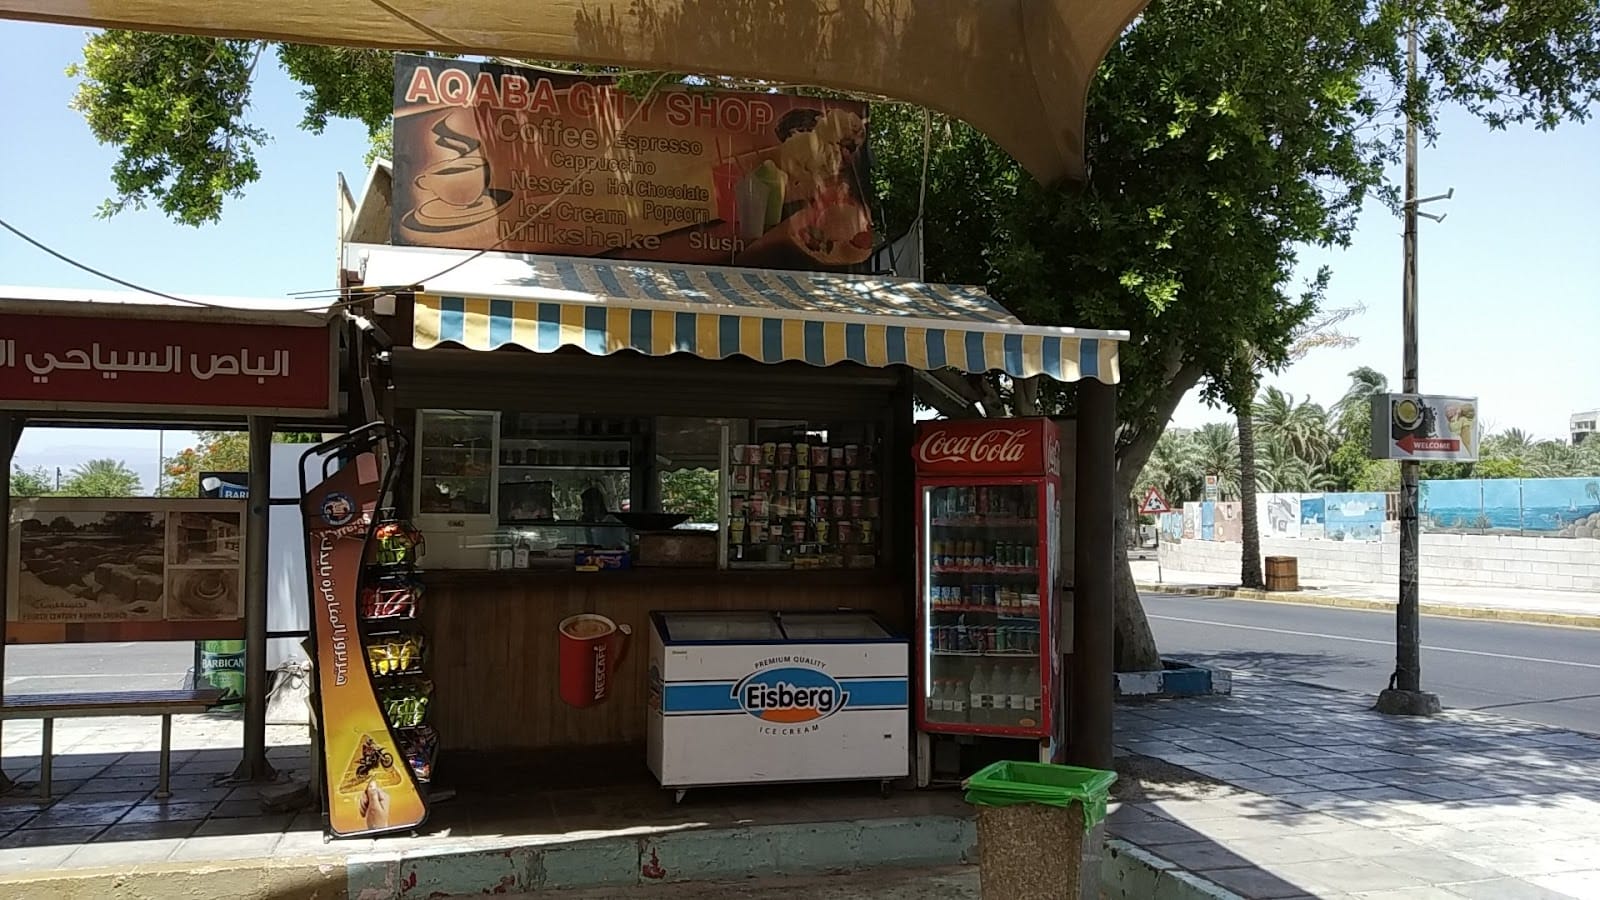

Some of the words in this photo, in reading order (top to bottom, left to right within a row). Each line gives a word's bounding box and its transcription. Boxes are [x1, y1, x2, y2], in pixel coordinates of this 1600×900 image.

[405, 66, 560, 115] AQABA
[567, 81, 660, 124] CITY
[666, 92, 774, 135] SHOP
[496, 114, 599, 150] Coffee
[614, 130, 703, 155] Espresso
[551, 150, 656, 175] Cappuccino
[607, 178, 634, 197] Hot
[636, 181, 709, 201] Chocolate
[518, 199, 551, 218] Ice
[556, 201, 627, 225] Cream
[644, 200, 710, 225] Popcorn
[499, 220, 661, 250] Milkshake
[688, 231, 745, 252] Slush
[24, 342, 182, 384] السياحي
[190, 348, 290, 384] الباص
[919, 428, 1033, 463] Coca-Cola
[1413, 441, 1451, 449] WELCOME
[224, 490, 249, 499] BAR
[202, 658, 245, 669] BARBICAN
[754, 656, 791, 669] PREMIUM
[793, 656, 827, 669] QUALITY
[746, 682, 834, 712] Eisberg
[759, 727, 777, 735] ICE
[782, 724, 818, 736] CREAM
